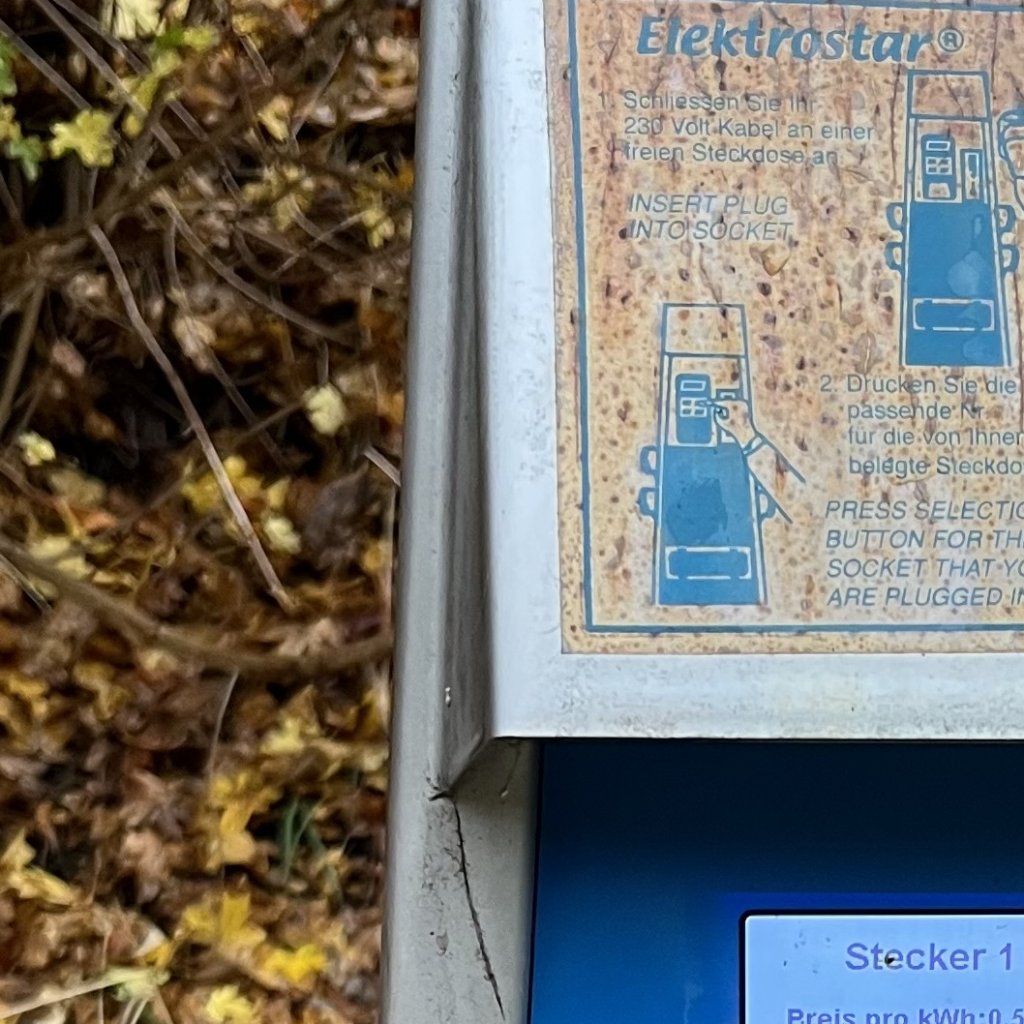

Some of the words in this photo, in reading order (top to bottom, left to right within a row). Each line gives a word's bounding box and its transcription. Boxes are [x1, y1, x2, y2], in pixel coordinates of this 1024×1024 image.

[624, 90, 738, 110] Schliessen
[747, 92, 780, 111] Sie
[625, 117, 663, 135] 230
[671, 118, 710, 135] Volt
[718, 118, 779, 137] Kabel
[787, 124, 813, 136] an
[821, 122, 874, 140] einer
[692, 143, 804, 163] Steckdose
[628, 193, 716, 213] INSERT
[723, 196, 788, 215] PLUG
[628, 220, 685, 238] INTO
[692, 221, 794, 240] SOCKET
[820, 375, 838, 392] 2.
[944, 376, 977, 394] Sie
[986, 376, 1016, 394] die
[847, 402, 951, 423] passende
[884, 427, 914, 445] die
[924, 431, 961, 445] von
[849, 456, 929, 479] belegte
[825, 501, 908, 519] PRESS
[826, 530, 925, 549] BUTTON
[933, 530, 982, 549] FOR
[827, 559, 929, 577] SOCKET
[936, 559, 996, 577] THAT
[827, 587, 877, 606] ARE
[885, 587, 1002, 606] PLUGGED
[845, 942, 986, 970] Stecker
[1000, 943, 1012, 970] 1
